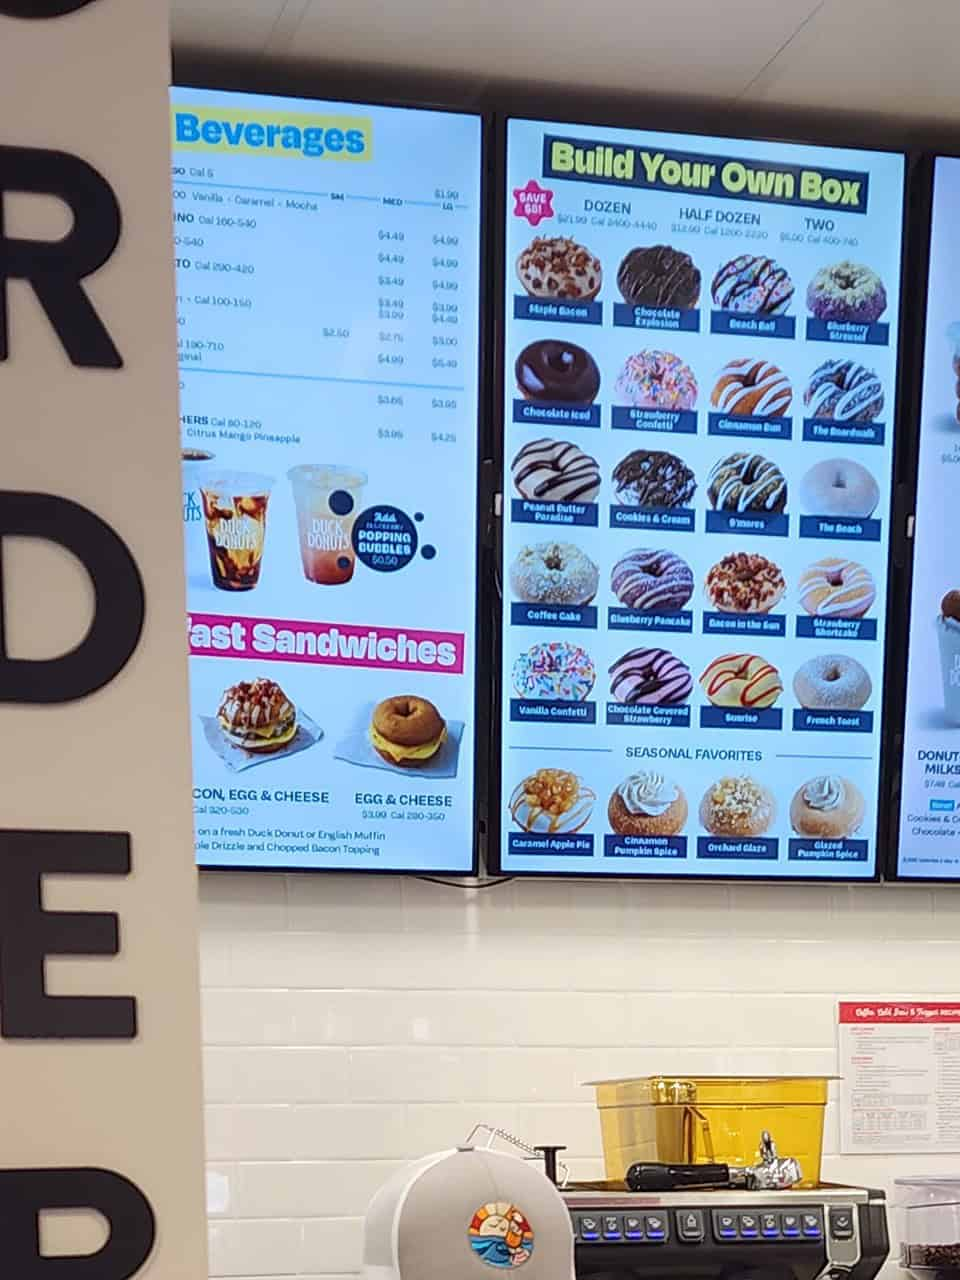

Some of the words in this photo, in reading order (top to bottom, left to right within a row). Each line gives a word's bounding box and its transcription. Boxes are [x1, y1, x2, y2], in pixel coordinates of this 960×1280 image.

[175, 113, 364, 157] Beverages
[551, 140, 634, 180] Build
[640, 151, 715, 189] Your
[721, 161, 795, 199] Own
[800, 170, 861, 206] Box
[193, 192, 223, 202] Vanilla
[235, 195, 274, 206] Caramel
[286, 200, 317, 211] Mocha
[519, 193, 547, 205] SAVE
[584, 199, 632, 215] DOZEN
[679, 207, 713, 222] HALF
[715, 210, 761, 226] DOZEN
[805, 217, 835, 232] TWO
[634, 306, 681, 320] Chocolate
[635, 316, 679, 329] Explosion
[729, 319, 755, 331] Beach
[827, 322, 869, 335] Blueberry
[523, 407, 568, 419] Chocolate
[570, 410, 590, 420] Iced
[630, 409, 679, 423] Strawberry
[636, 418, 673, 430] Confetti
[718, 419, 760, 431] Cinnamon
[187, 428, 216, 438] Citrus
[220, 430, 251, 441] Mango
[254, 433, 300, 444] Pineapple
[813, 424, 828, 436] The
[829, 426, 875, 439] Boardwalk
[523, 502, 554, 514] Peanut
[556, 503, 586, 514] Butter
[615, 512, 650, 524] Cookies
[652, 514, 660, 524] &
[661, 514, 691, 525] Cream
[220, 519, 250, 534] DUCK
[312, 519, 344, 534] DUCK
[819, 523, 834, 533] The
[836, 524, 862, 535] Beach
[215, 532, 258, 550] DONUTS
[307, 533, 351, 551] DONUTS
[358, 530, 411, 543] POPPING
[528, 610, 555, 621] Coffee
[557, 612, 581, 622] Cake
[610, 613, 652, 627] Blueberry
[653, 616, 691, 627] Pancake
[709, 618, 737, 629] Bacon
[744, 619, 757, 630] the
[813, 618, 861, 631] Strawberry
[815, 627, 858, 638] Shortcake
[252, 623, 457, 665] Sandwiches
[519, 705, 549, 716] Vanilla
[551, 706, 588, 717] Confetti
[607, 704, 652, 716] Chocolate
[653, 705, 689, 717] Covered
[623, 714, 673, 726] Strawberry
[725, 713, 758, 724] Sunrise
[806, 715, 835, 727] French
[836, 716, 860, 727] Toast
[625, 746, 693, 759] SEASONAL
[696, 748, 763, 761] FAVORITES
[229, 789, 257, 801] EGG
[261, 790, 272, 801] &
[274, 791, 329, 803] CHEESE
[355, 793, 383, 805] EGG
[386, 794, 397, 805] &
[399, 795, 453, 807] CHEESE
[907, 814, 941, 823] Cookies
[944, 815, 950, 823] &
[220, 828, 245, 837] fresh
[247, 828, 273, 837] Duck
[275, 829, 304, 838] Donut
[318, 830, 352, 841] English
[354, 831, 385, 840] Muffin
[912, 827, 955, 837] Chocolate
[512, 839, 548, 849] Caramel
[550, 839, 575, 851] Apple
[576, 840, 590, 850] Pie
[624, 836, 668, 846] Cinnamon
[814, 840, 844, 850] Glazed
[211, 841, 245, 851] Drizzle
[247, 842, 264, 851] and
[267, 843, 309, 855] Chopped
[312, 844, 340, 853] Bacon
[343, 845, 380, 855] Topping
[614, 846, 652, 857] Pumpkin
[653, 846, 678, 857] Spice
[708, 842, 741, 853] Orchard
[743, 843, 767, 854] Glaze
[797, 849, 834, 859] Pumpkin
[835, 850, 859, 860] Spice
